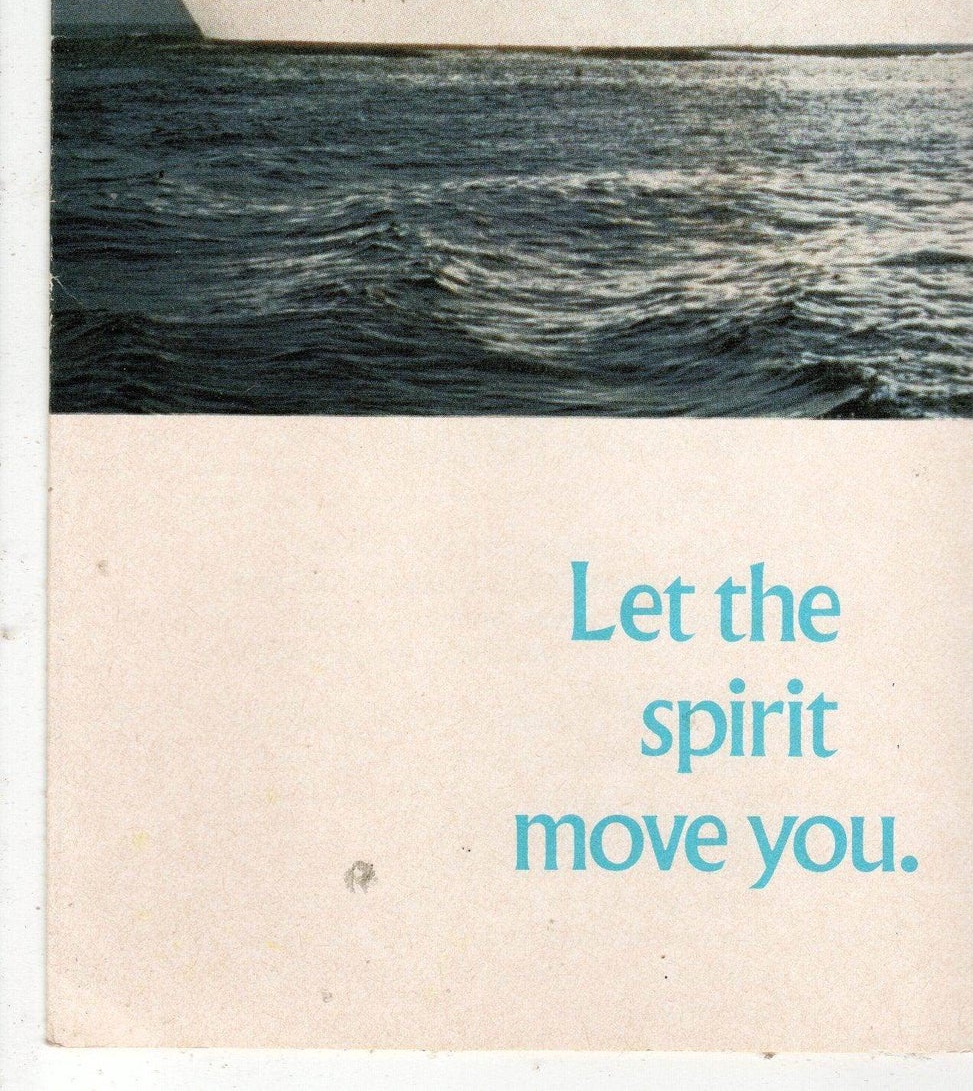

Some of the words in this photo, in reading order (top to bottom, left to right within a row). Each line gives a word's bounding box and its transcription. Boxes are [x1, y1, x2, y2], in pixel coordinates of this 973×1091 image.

[571, 561, 695, 642] Let
[716, 563, 841, 643] the
[641, 678, 838, 774] spirit
[515, 814, 728, 872] move
[748, 815, 918, 889] you.
